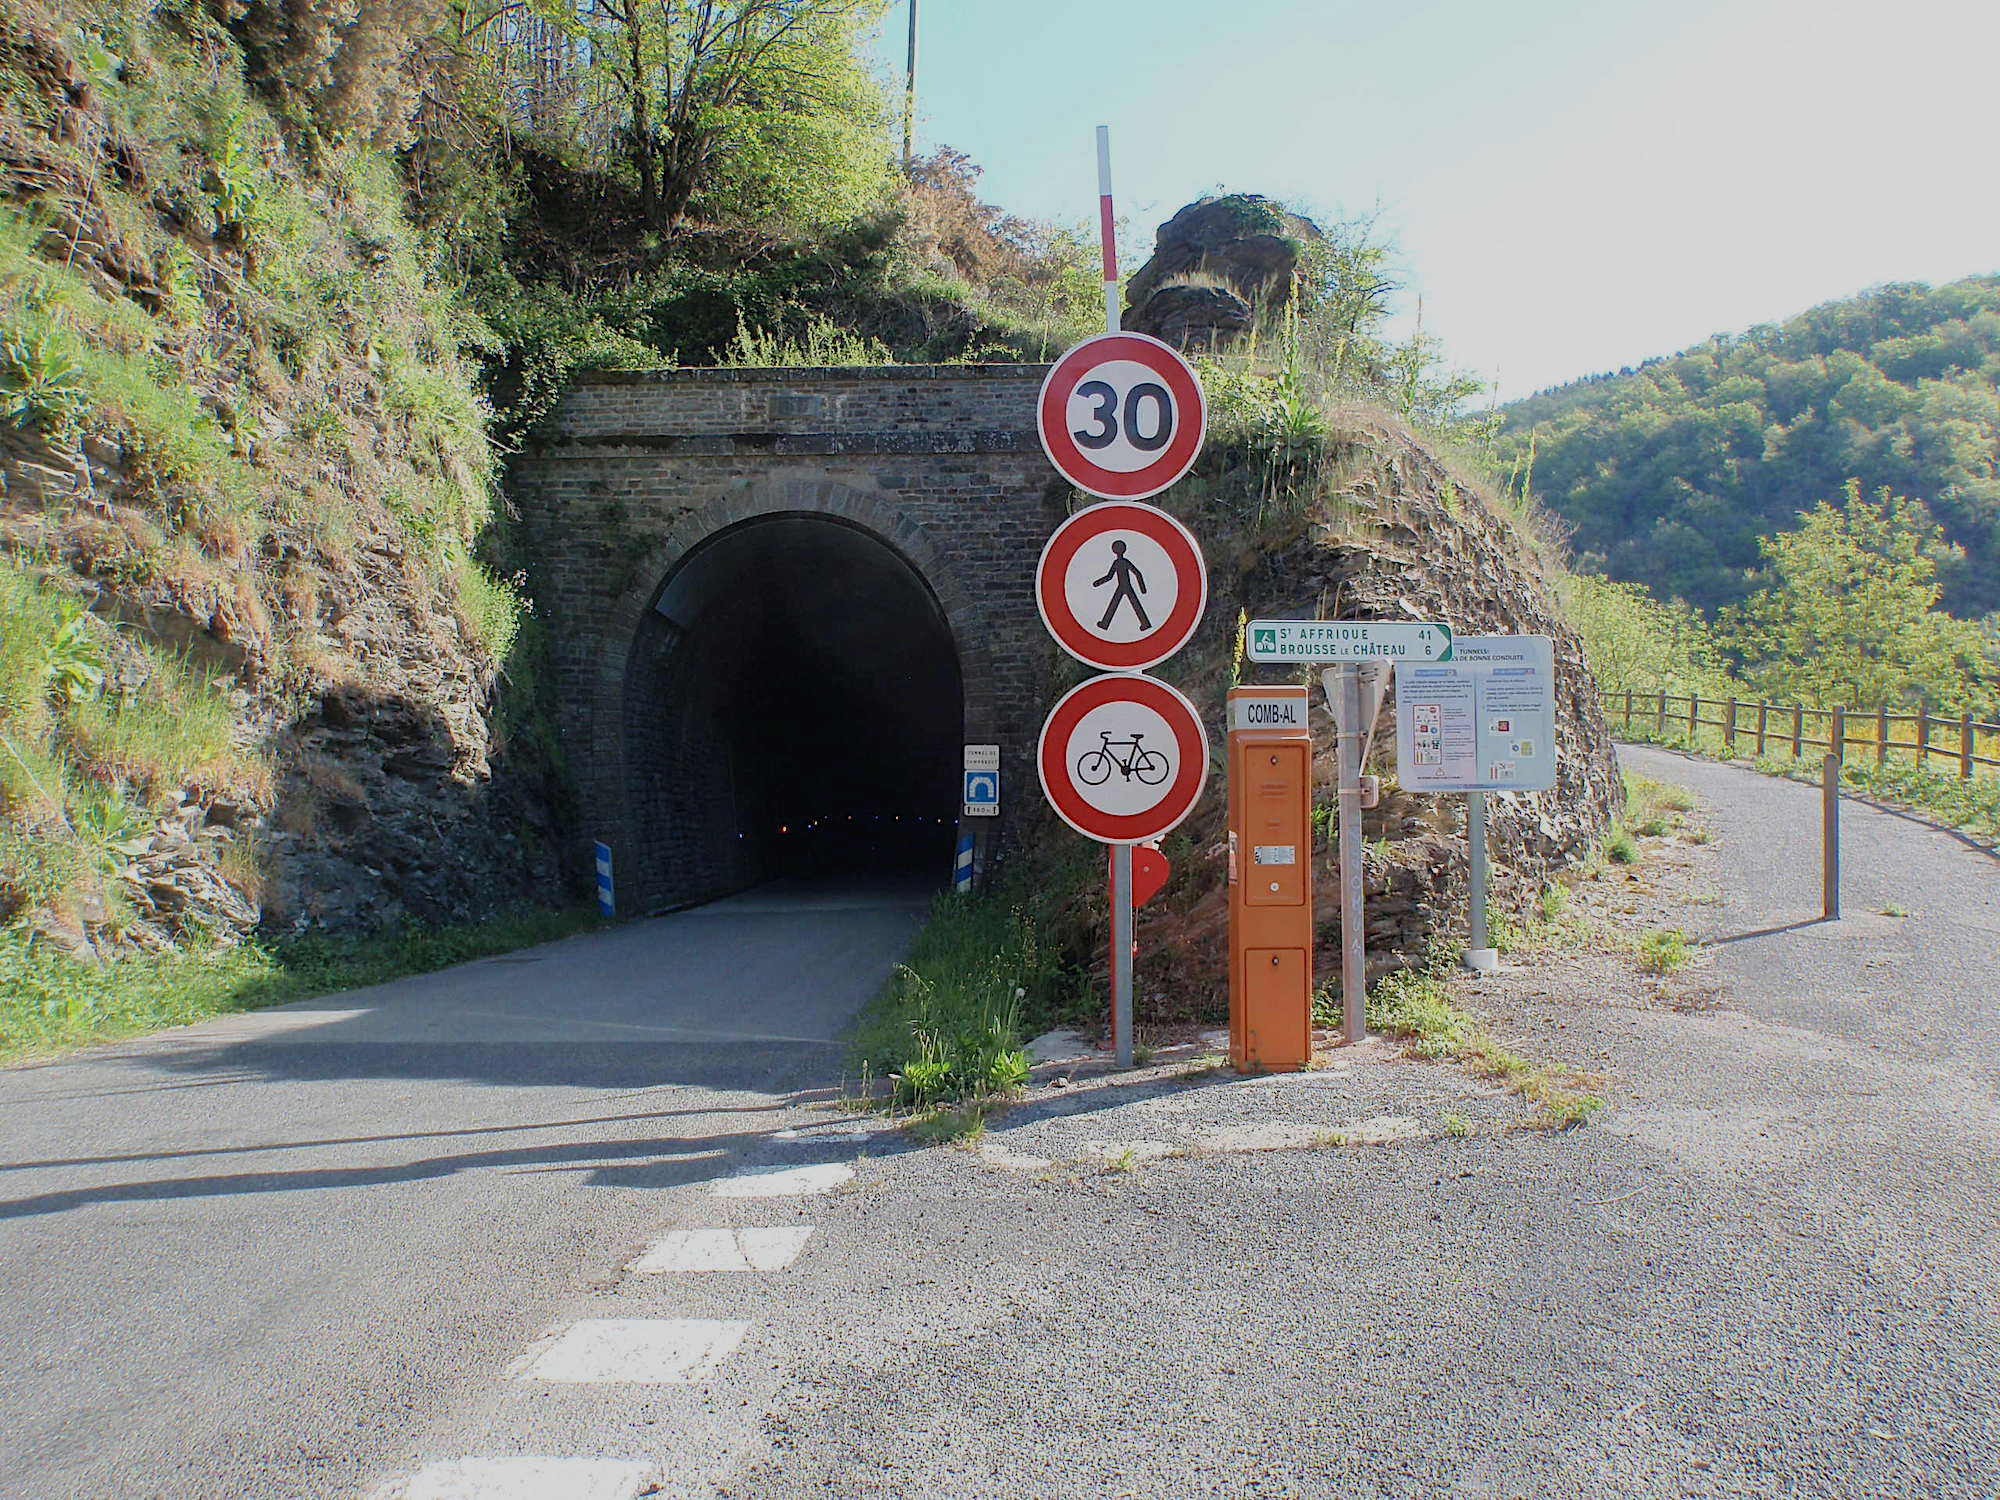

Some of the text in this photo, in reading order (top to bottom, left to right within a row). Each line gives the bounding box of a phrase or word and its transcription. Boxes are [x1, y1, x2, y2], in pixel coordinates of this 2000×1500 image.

[1073, 381, 1173, 452] 30
[1300, 628, 1369, 640] AFFRIQUE
[1418, 630, 1431, 641] 41
[1280, 644, 1336, 655] BROUSSE
[1353, 642, 1406, 656] CHÂTEAU
[1425, 645, 1432, 655] 6
